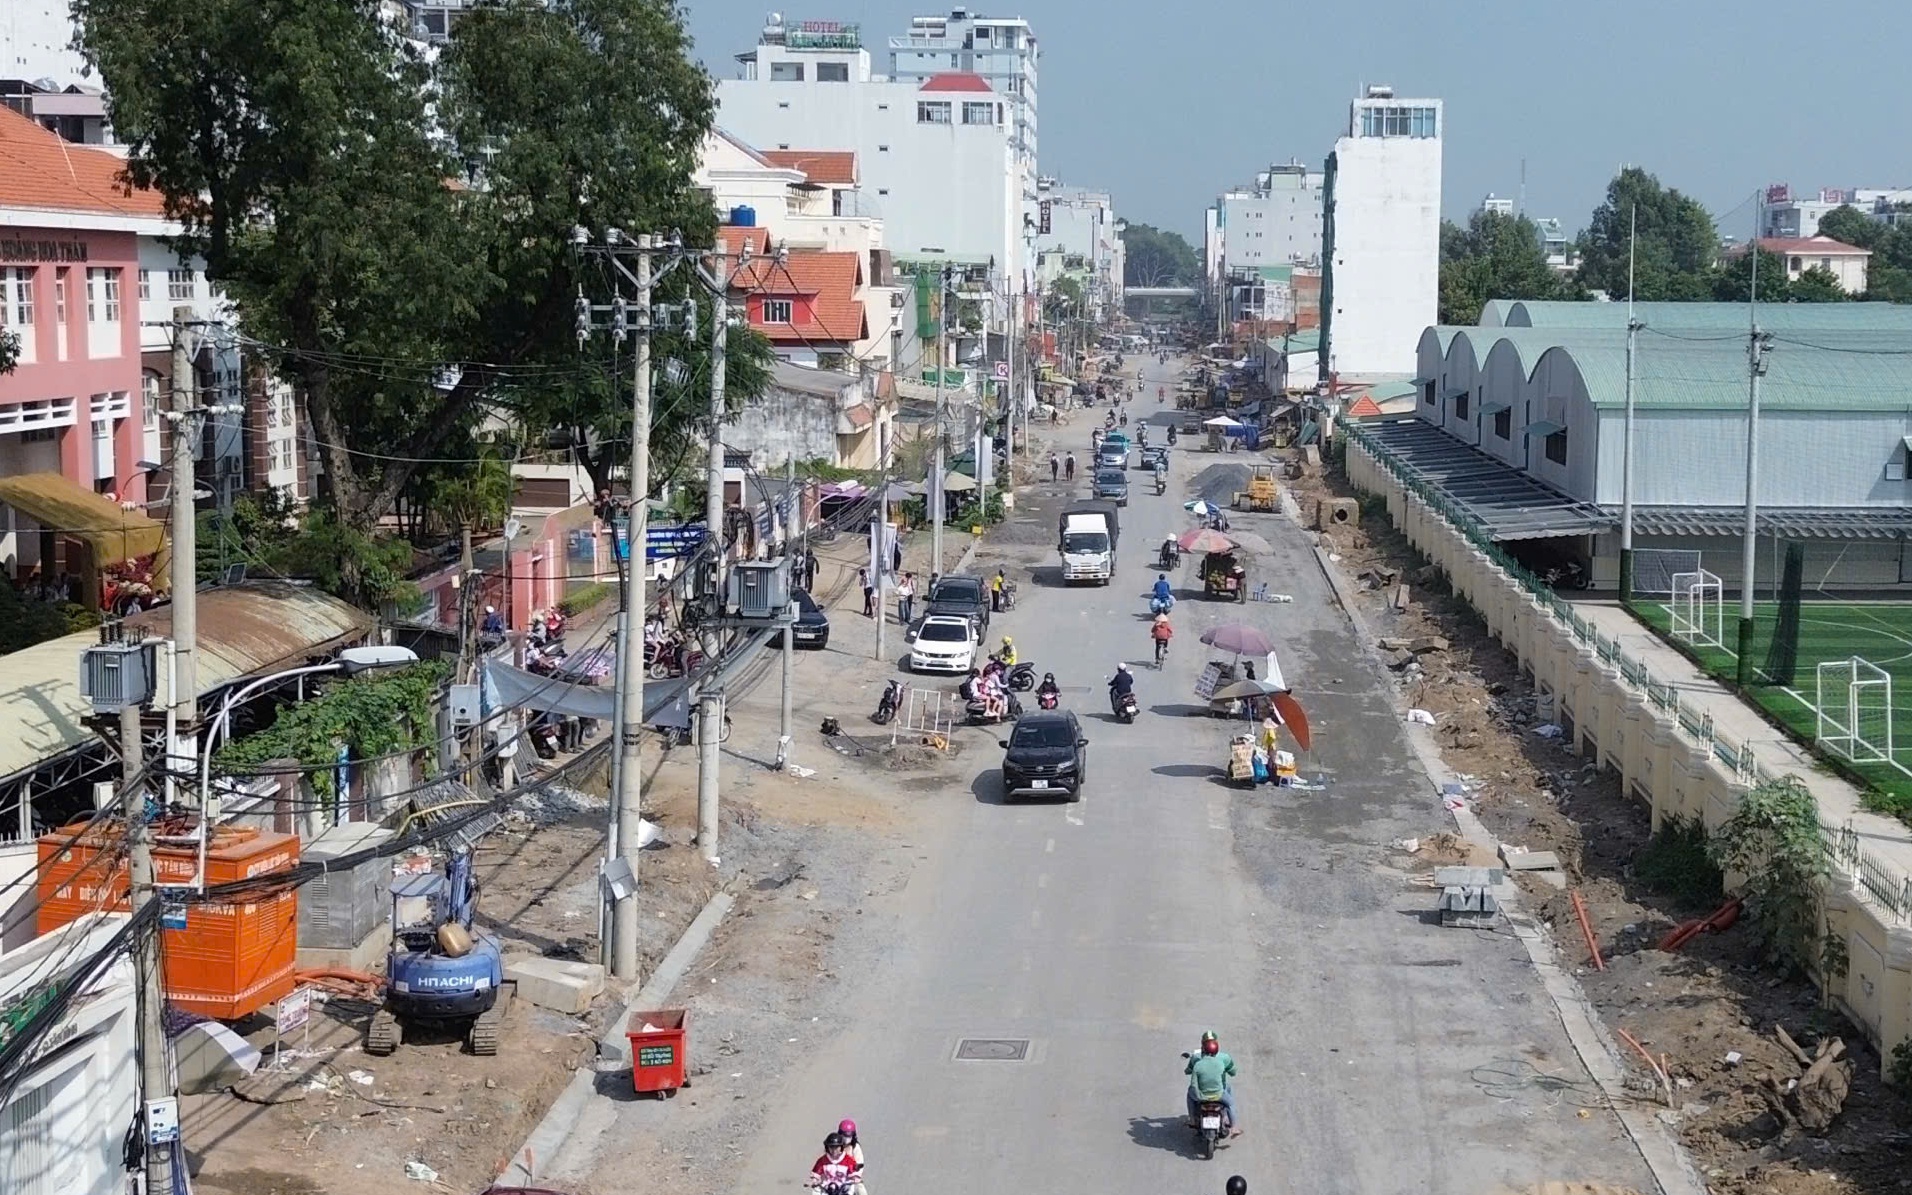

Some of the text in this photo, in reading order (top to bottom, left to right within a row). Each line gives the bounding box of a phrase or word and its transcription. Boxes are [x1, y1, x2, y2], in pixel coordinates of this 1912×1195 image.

[803, 21, 841, 33] HOTEL
[1041, 201, 1050, 233] HOTEL
[417, 975, 474, 987] HITACHI
